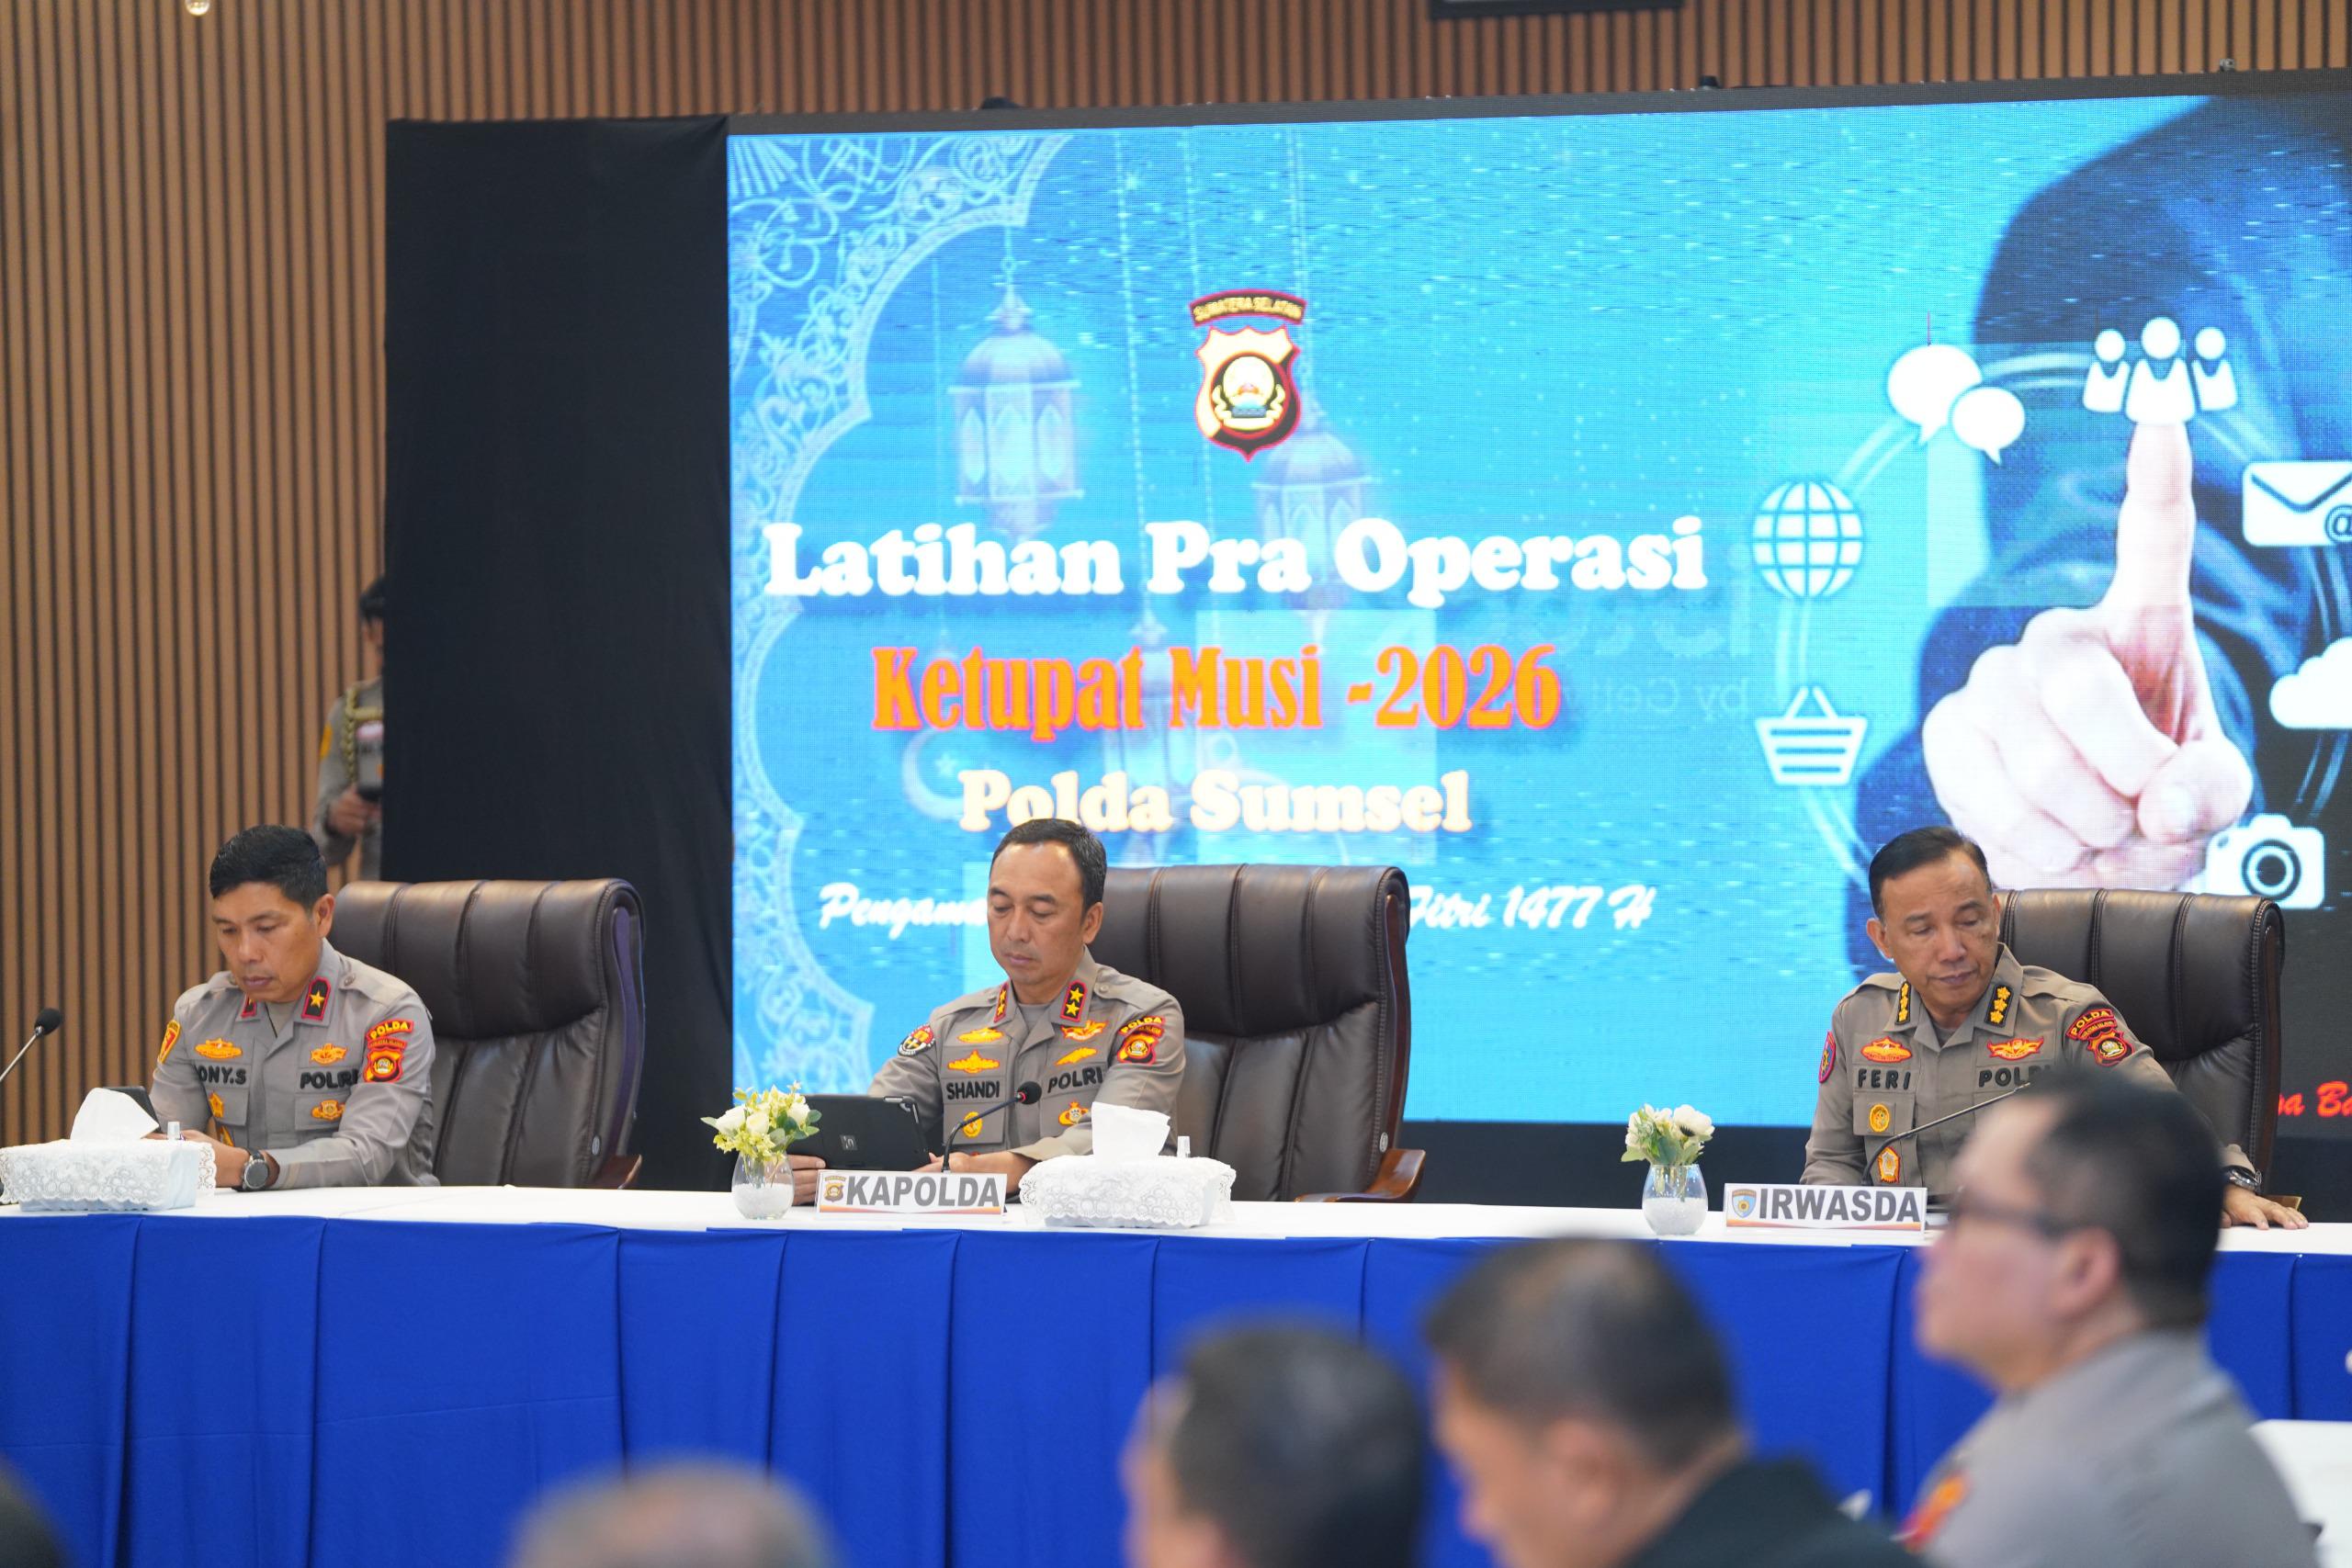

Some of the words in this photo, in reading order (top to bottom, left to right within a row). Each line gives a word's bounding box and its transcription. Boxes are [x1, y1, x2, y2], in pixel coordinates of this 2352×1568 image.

[763, 522, 1124, 596] Latihan
[1146, 521, 1313, 594] Pra
[1334, 516, 1707, 608] Operasi
[872, 645, 1147, 742] Ketupat
[1168, 644, 1325, 730] Musi
[1347, 644, 1562, 730] -2026
[957, 769, 1176, 833] Polda
[1190, 761, 1474, 833] Sumsel
[820, 882, 988, 940] Pengama
[1503, 885, 1603, 929] 1477
[1608, 885, 1657, 930] H
[369, 1021, 409, 1041] POLDA
[1121, 1017, 1162, 1034] POLDA
[2070, 1010, 2110, 1036] POLDA
[198, 1065, 247, 1085] ONY.S
[300, 1068, 359, 1089] POLRI
[1047, 1066, 1103, 1094] POLRI
[1857, 1067, 1912, 1090] FERI
[945, 1080, 1001, 1100] SHANDI
[845, 1175, 1001, 1208] KAPOLDA
[1758, 1188, 1921, 1223] IRWASDA
